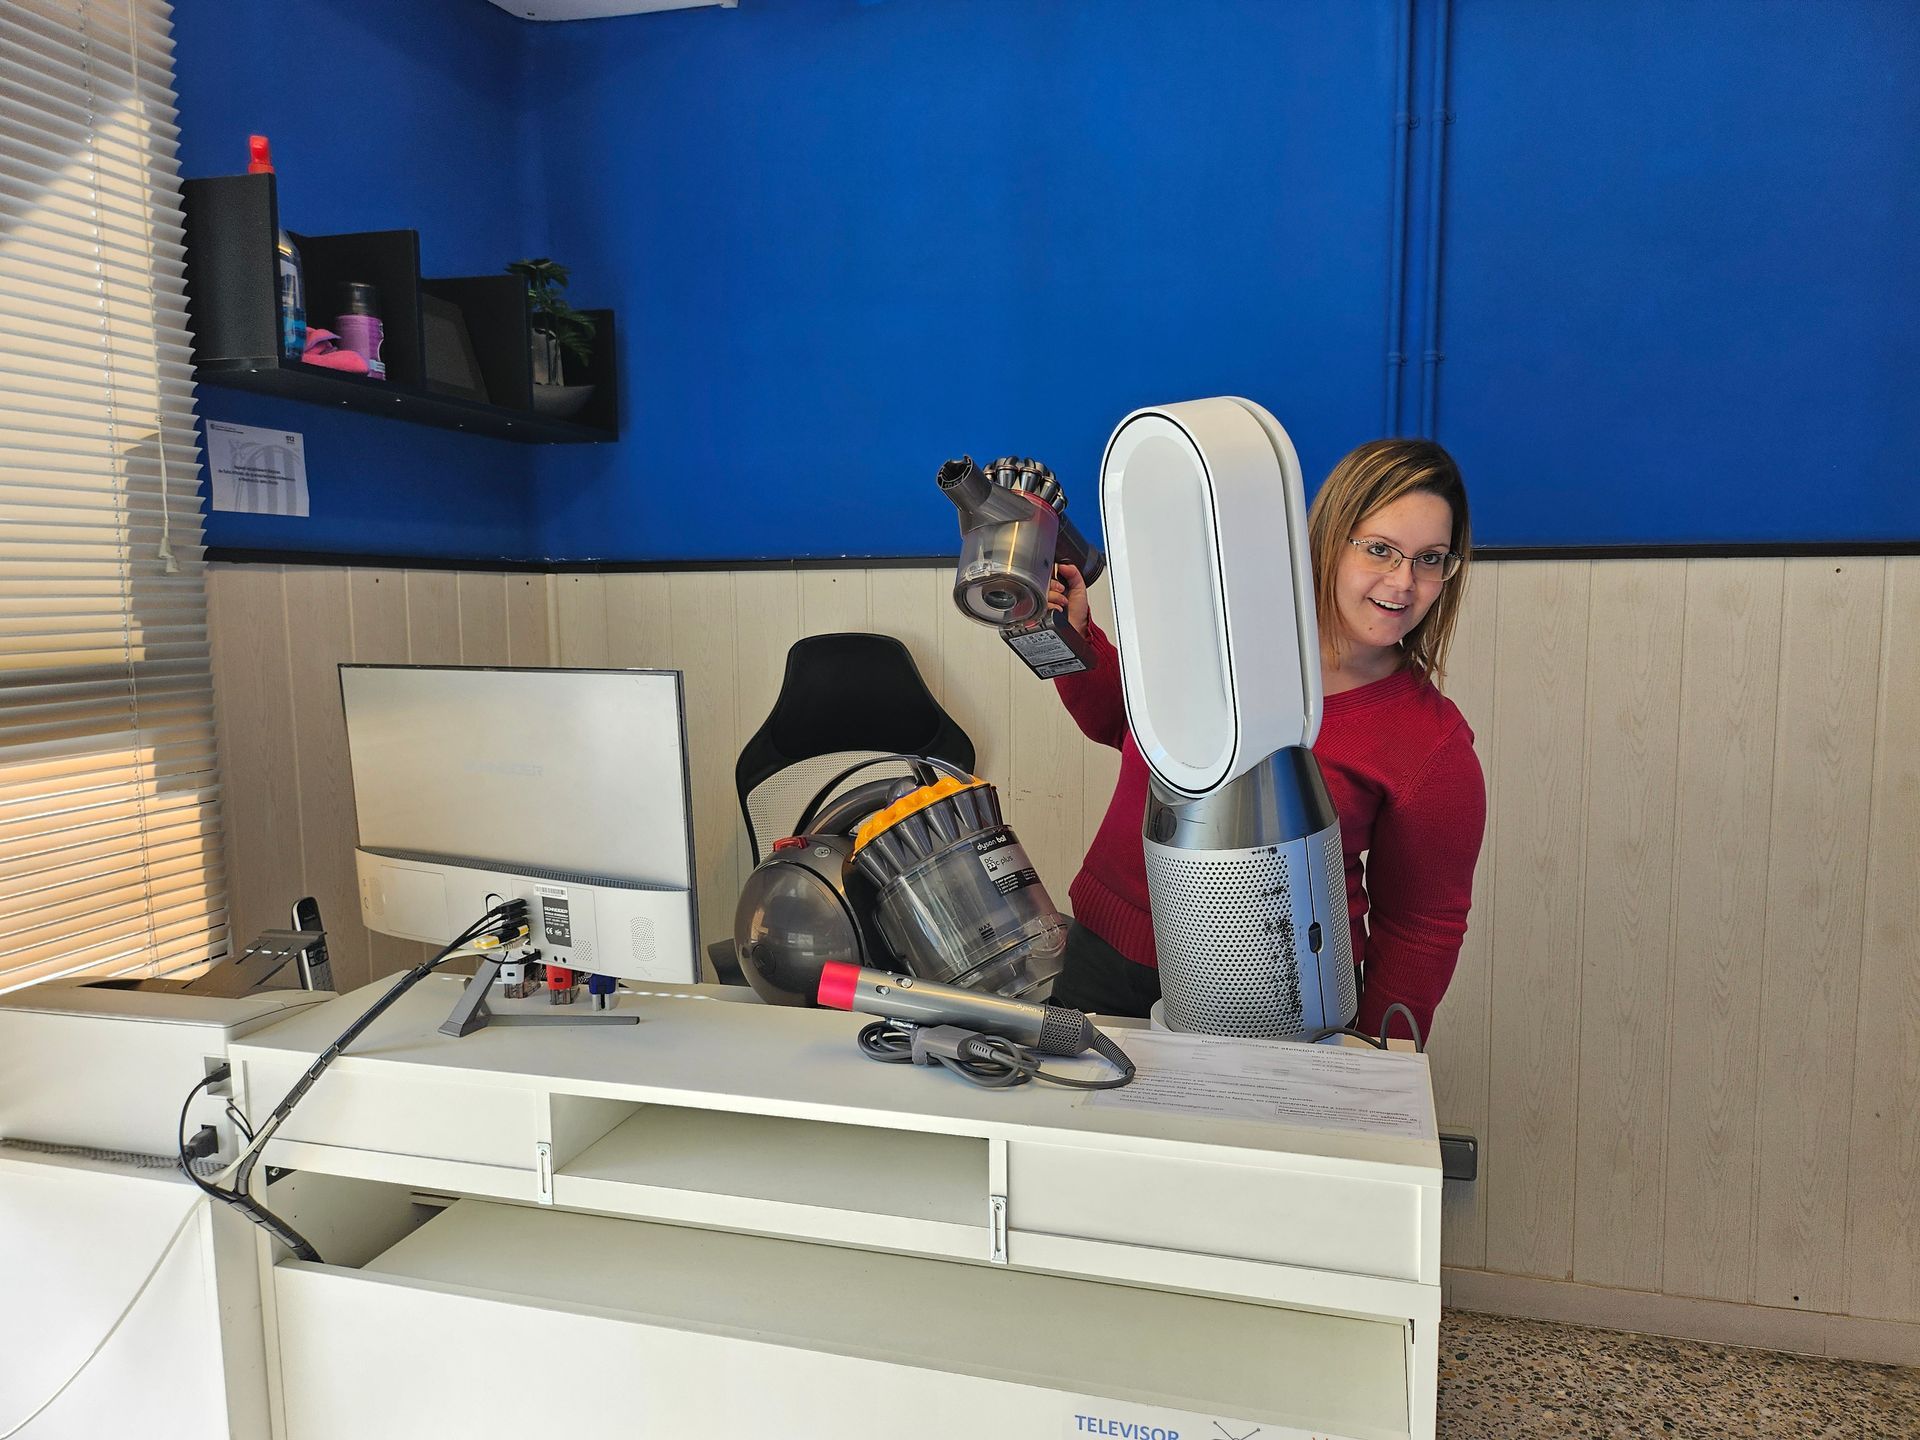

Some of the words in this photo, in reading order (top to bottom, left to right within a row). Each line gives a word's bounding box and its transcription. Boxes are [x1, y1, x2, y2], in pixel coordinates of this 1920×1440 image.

[977, 839, 997, 850] dyson
[1000, 856, 1013, 866] plus
[978, 922, 991, 931] MAX
[1016, 1003, 1036, 1012] dyson
[1074, 1415, 1180, 1440] TELEVISOR
